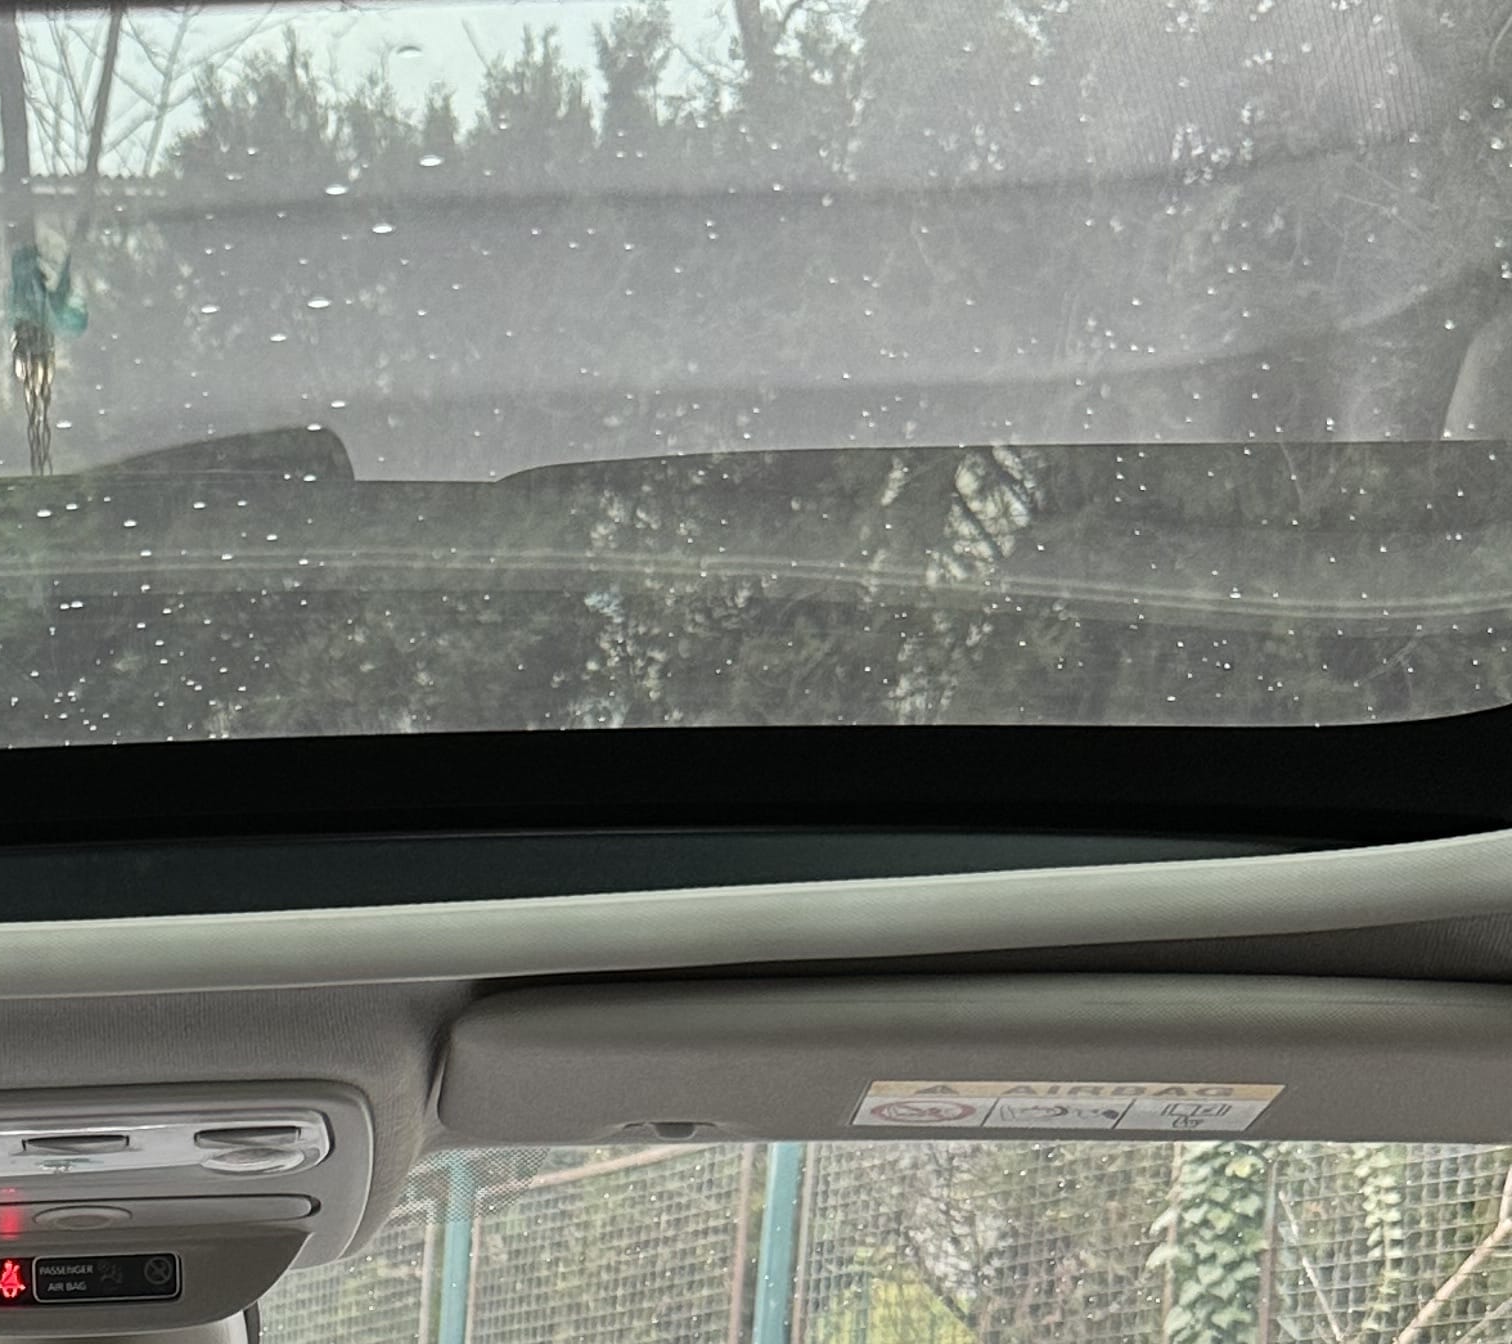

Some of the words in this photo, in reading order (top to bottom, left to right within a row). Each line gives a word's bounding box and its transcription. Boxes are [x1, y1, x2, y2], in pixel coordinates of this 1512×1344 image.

[1001, 1085, 1235, 1097] AIRBAG
[39, 1265, 94, 1276] PASSENGER
[48, 1282, 65, 1292] AIR
[66, 1281, 87, 1292] BAG
